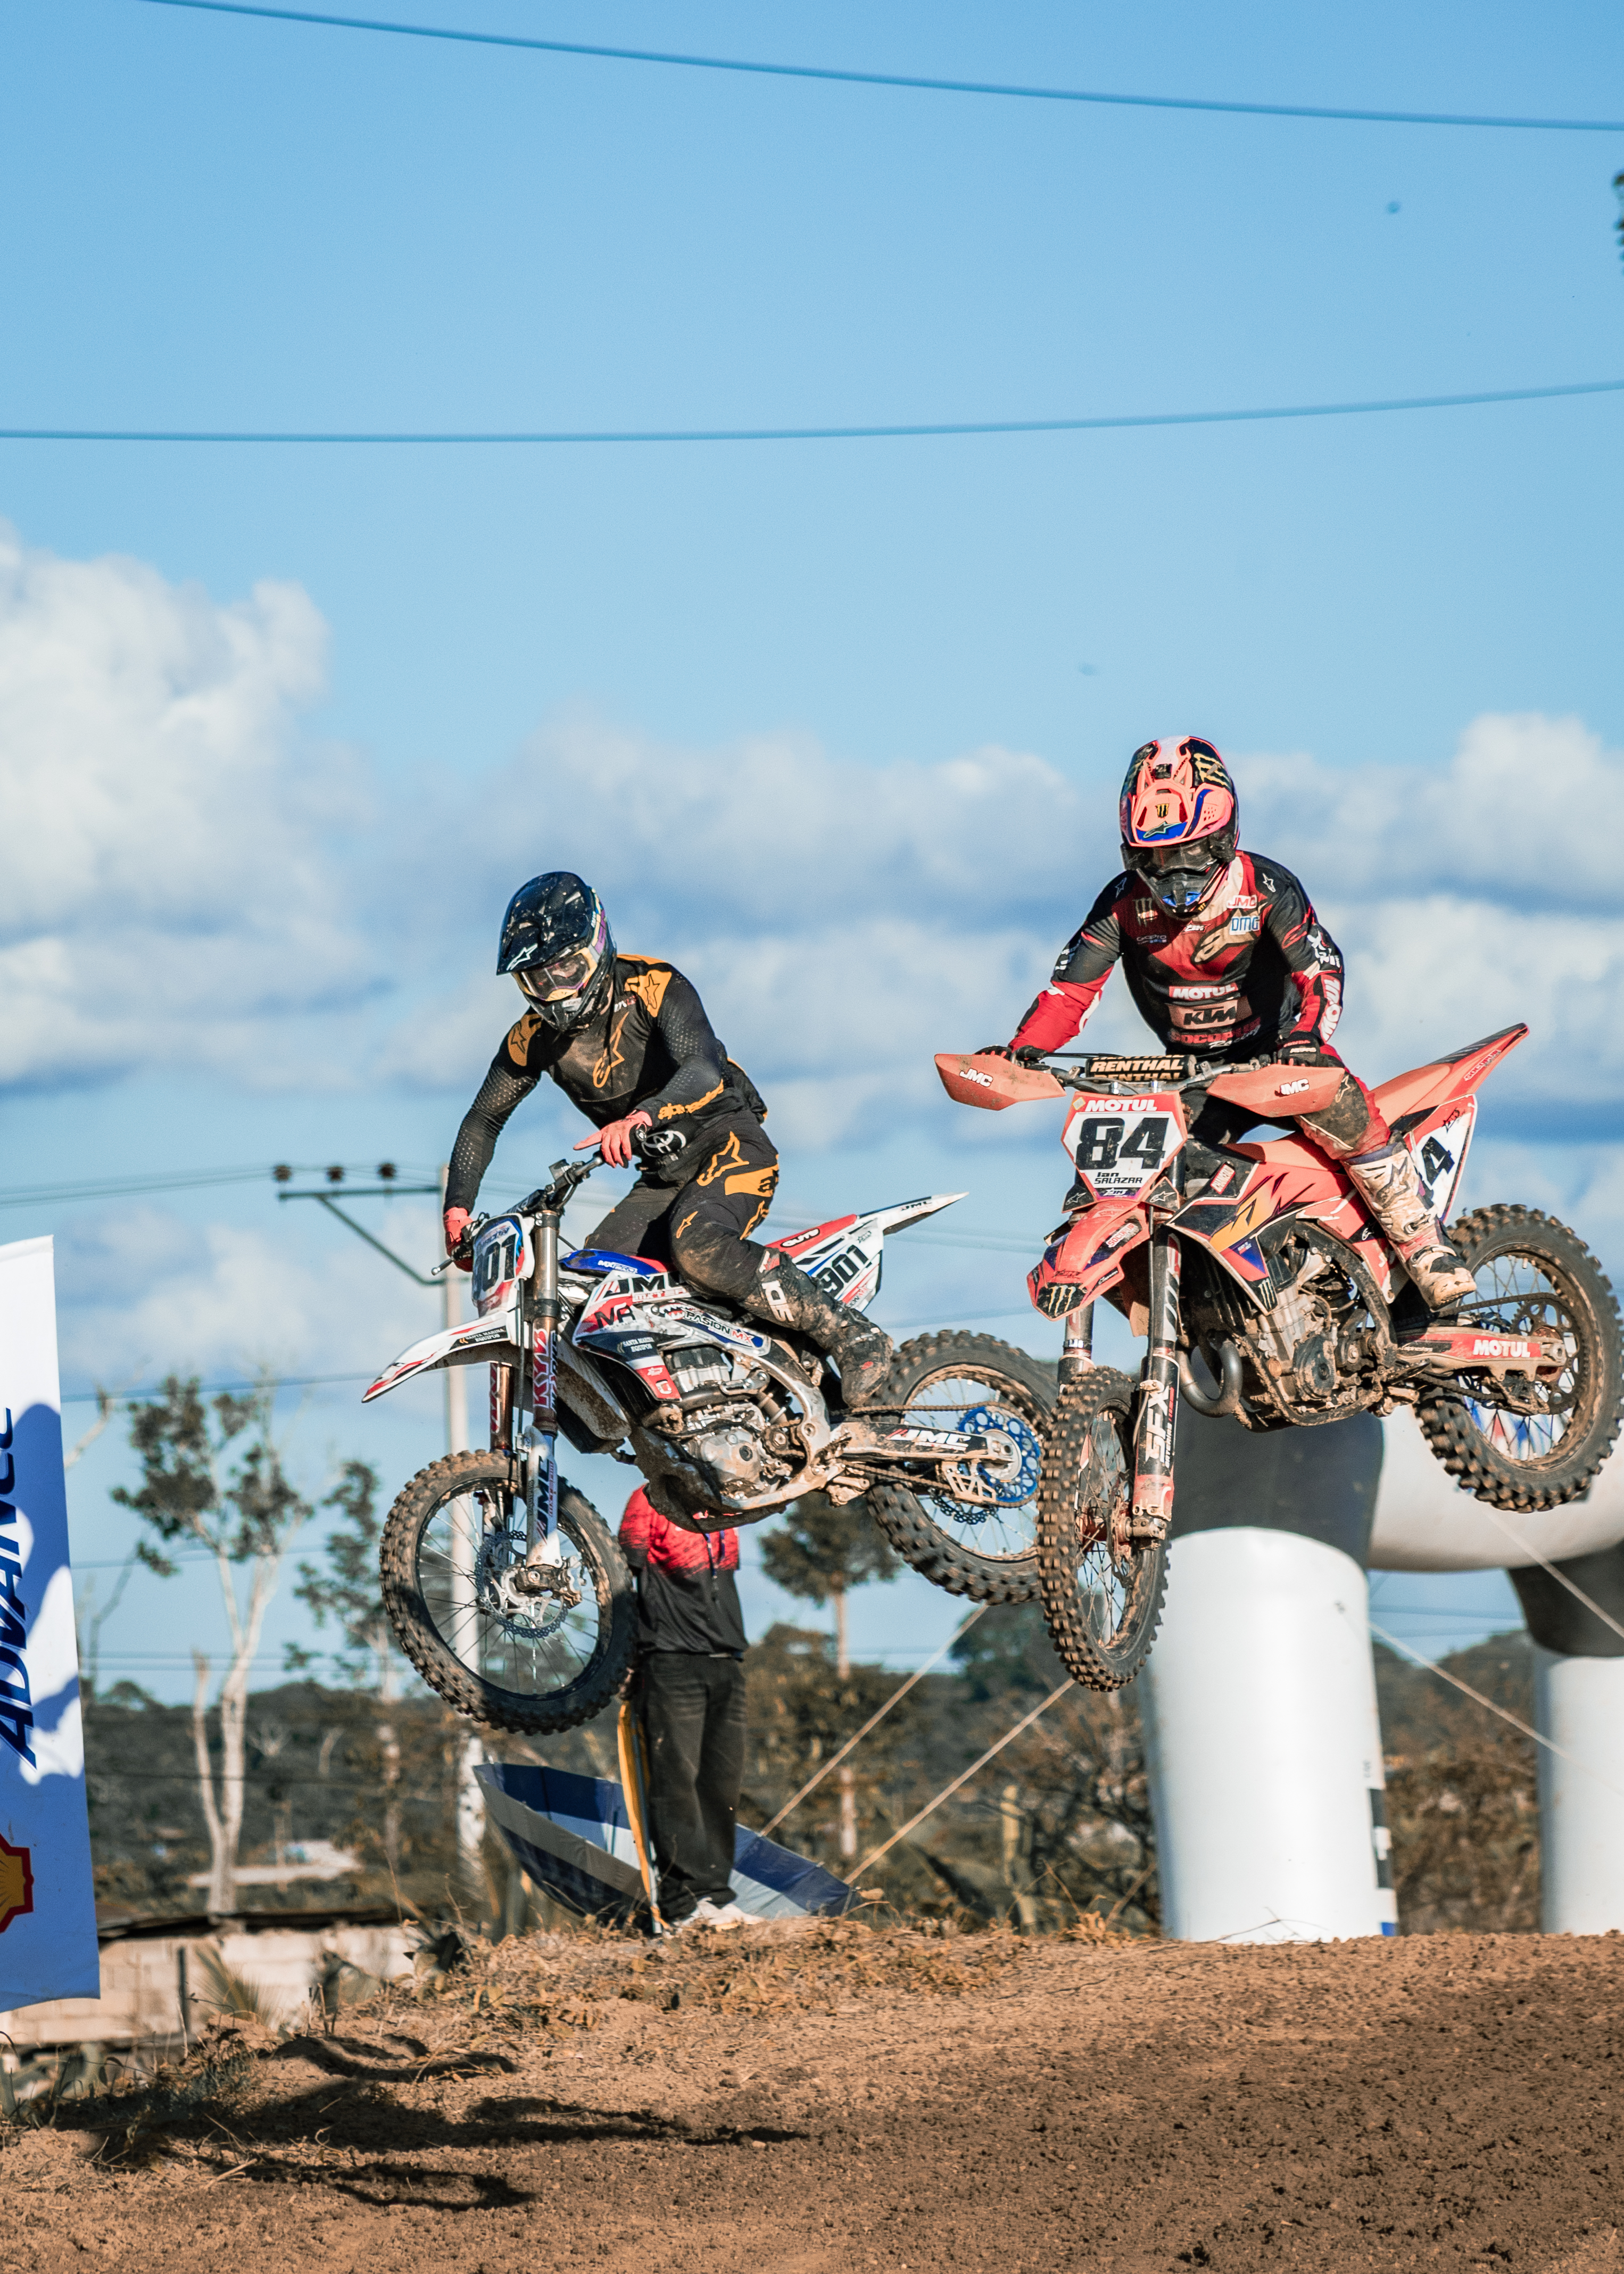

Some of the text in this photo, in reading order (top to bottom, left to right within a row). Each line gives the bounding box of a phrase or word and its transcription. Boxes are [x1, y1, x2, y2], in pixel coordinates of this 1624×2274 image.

[1231, 916, 1260, 931] DMG
[1172, 984, 1236, 999] MOTUL
[1183, 1006, 1237, 1025] KTM
[1090, 1059, 1183, 1072] RENTHAL
[959, 1068, 993, 1087] JMC
[1275, 1078, 1310, 1096] JMC
[1085, 1099, 1157, 1112] MOTUL
[1075, 1118, 1170, 1170] 84
[816, 1244, 872, 1299] 901
[685, 1311, 753, 1344] PASION MX
[1472, 1339, 1531, 1358] MOTUL
[532, 1328, 550, 1409] KYB
[1145, 1385, 1171, 1464] SFX
[890, 1429, 972, 1448] JMC
[537, 1455, 550, 1538] JMC
